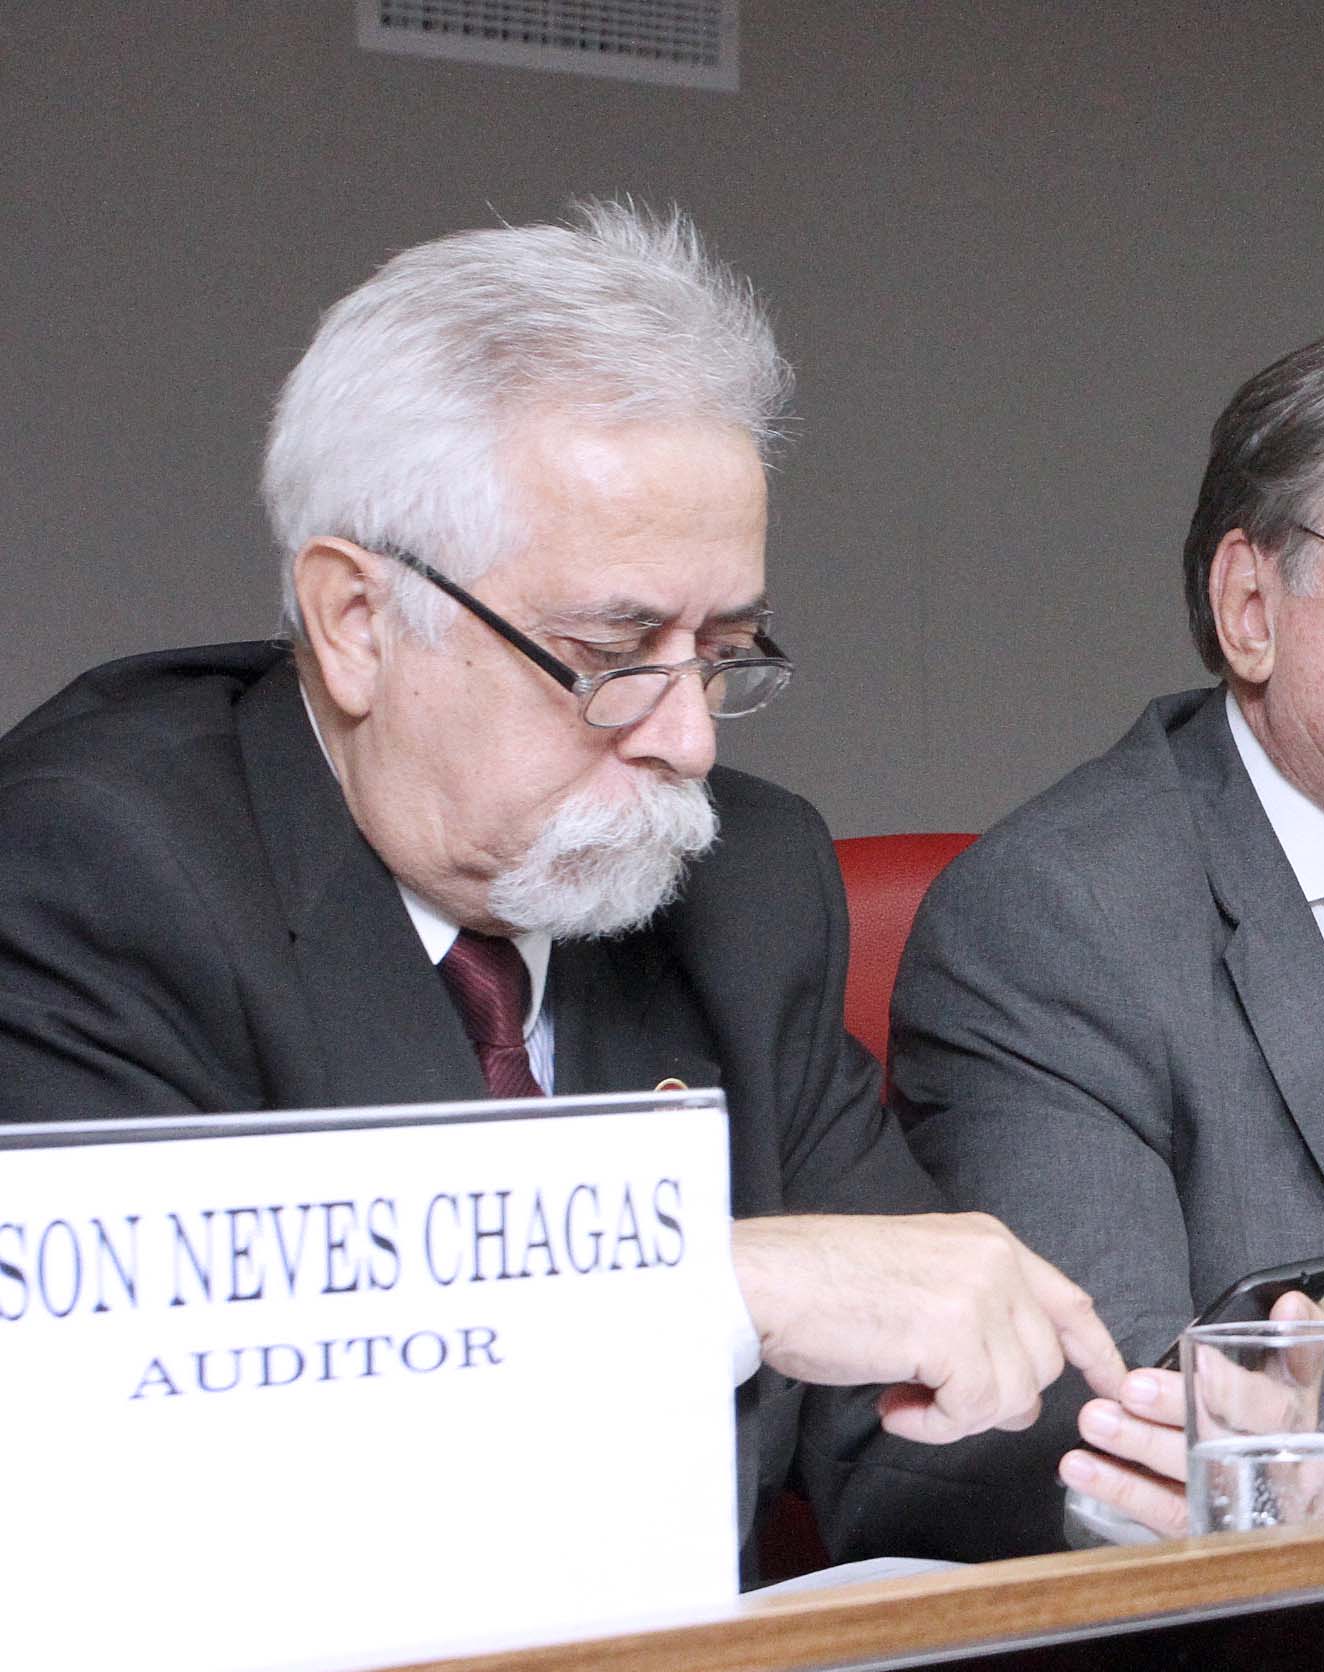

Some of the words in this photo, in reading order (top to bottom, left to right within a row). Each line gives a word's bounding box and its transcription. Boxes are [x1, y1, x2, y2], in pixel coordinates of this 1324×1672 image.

[167, 1197, 400, 1307] NEVES
[424, 1178, 686, 1287] CHAGAS
[129, 1327, 504, 1400] AUDITOR
